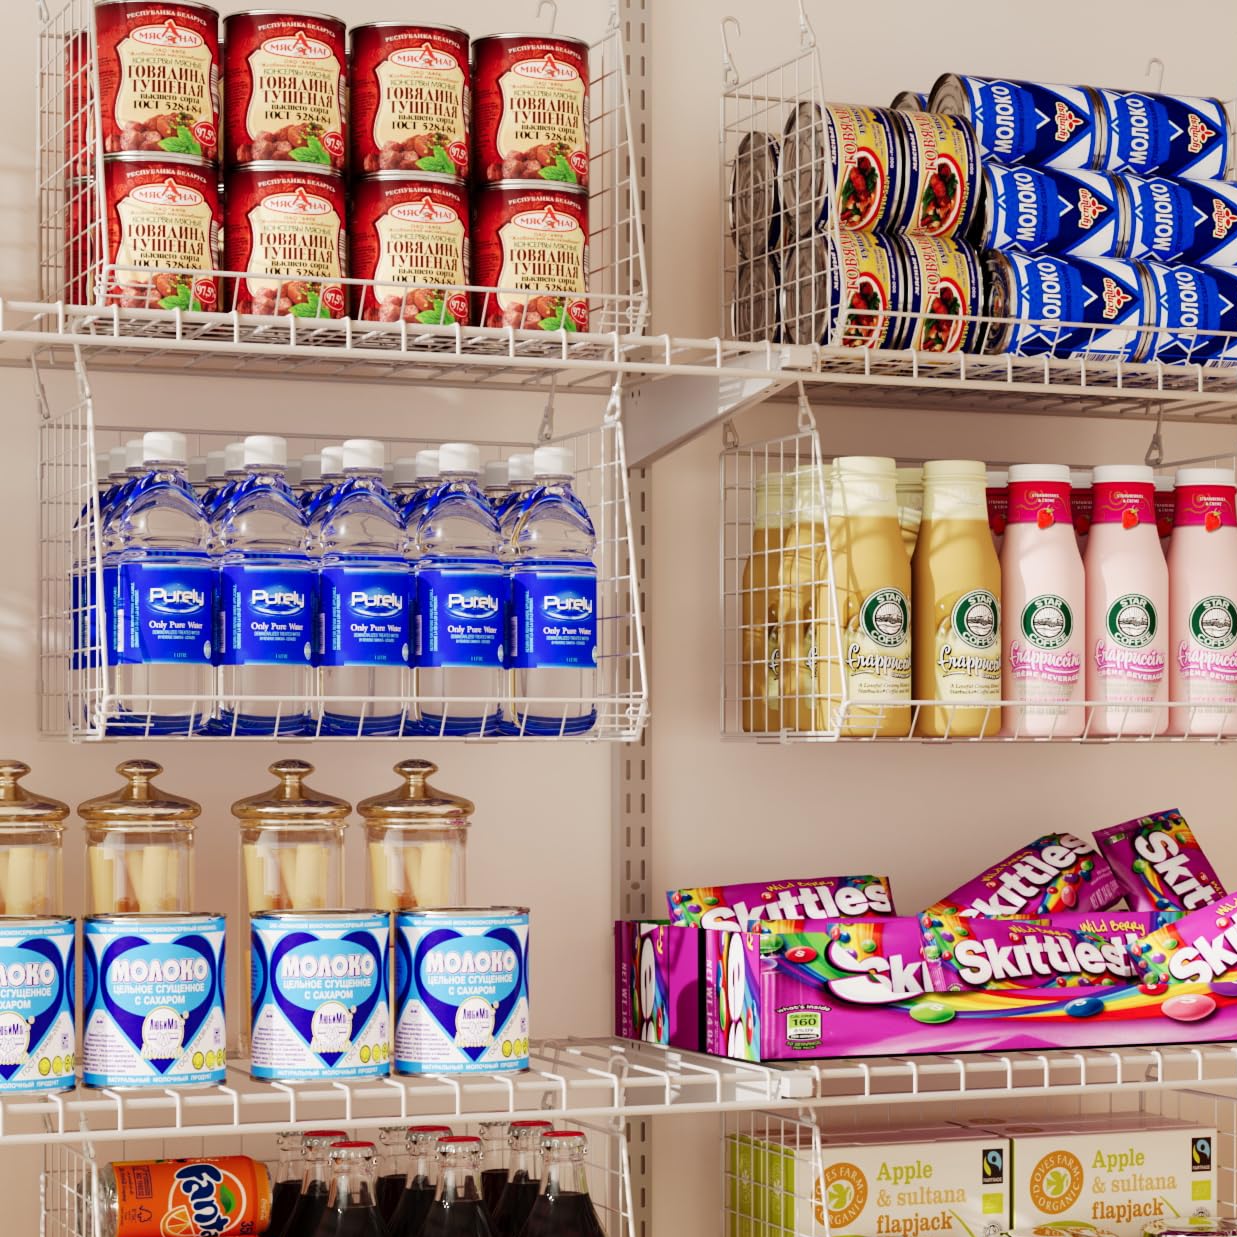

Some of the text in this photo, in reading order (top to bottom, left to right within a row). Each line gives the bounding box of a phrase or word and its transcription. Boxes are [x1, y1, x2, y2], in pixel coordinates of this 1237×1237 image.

[133, 79, 203, 98] ТУШЕНАЯ
[133, 100, 160, 110] ГОСТ
[391, 100, 458, 120] ТУШЕНАЯ
[992, 83, 1016, 154] МОЛОКО
[1127, 96, 1146, 166] МОЛОКО
[1016, 172, 1039, 242] МОЛОКО
[1152, 182, 1170, 252] МОЛОКО
[149, 587, 204, 608] Purely
[251, 589, 304, 609] Purely
[351, 591, 402, 610] Purely
[877, 593, 902, 605] STAR
[1035, 598, 1062, 608] STAR
[1120, 597, 1147, 608] STAR
[149, 620, 186, 631] Only Pure
[701, 884, 892, 932] Skittles
[1080, 920, 1146, 937] Wild Berry
[111, 958, 209, 982] МОЛОКО
[281, 953, 375, 978] МОЛОКО
[955, 936, 1127, 986] Skittles
[113, 982, 205, 994] ЦЕЛЬНОЕ СГУЩЕННОЕ
[143, 995, 185, 1005] САХАРОМ
[1092, 1148, 1145, 1172] Apple
[876, 1161, 933, 1185] Apple
[1092, 1173, 1178, 1193] & sultana
[1091, 1197, 1164, 1223] flapjack
[876, 1212, 953, 1237] flapjack
